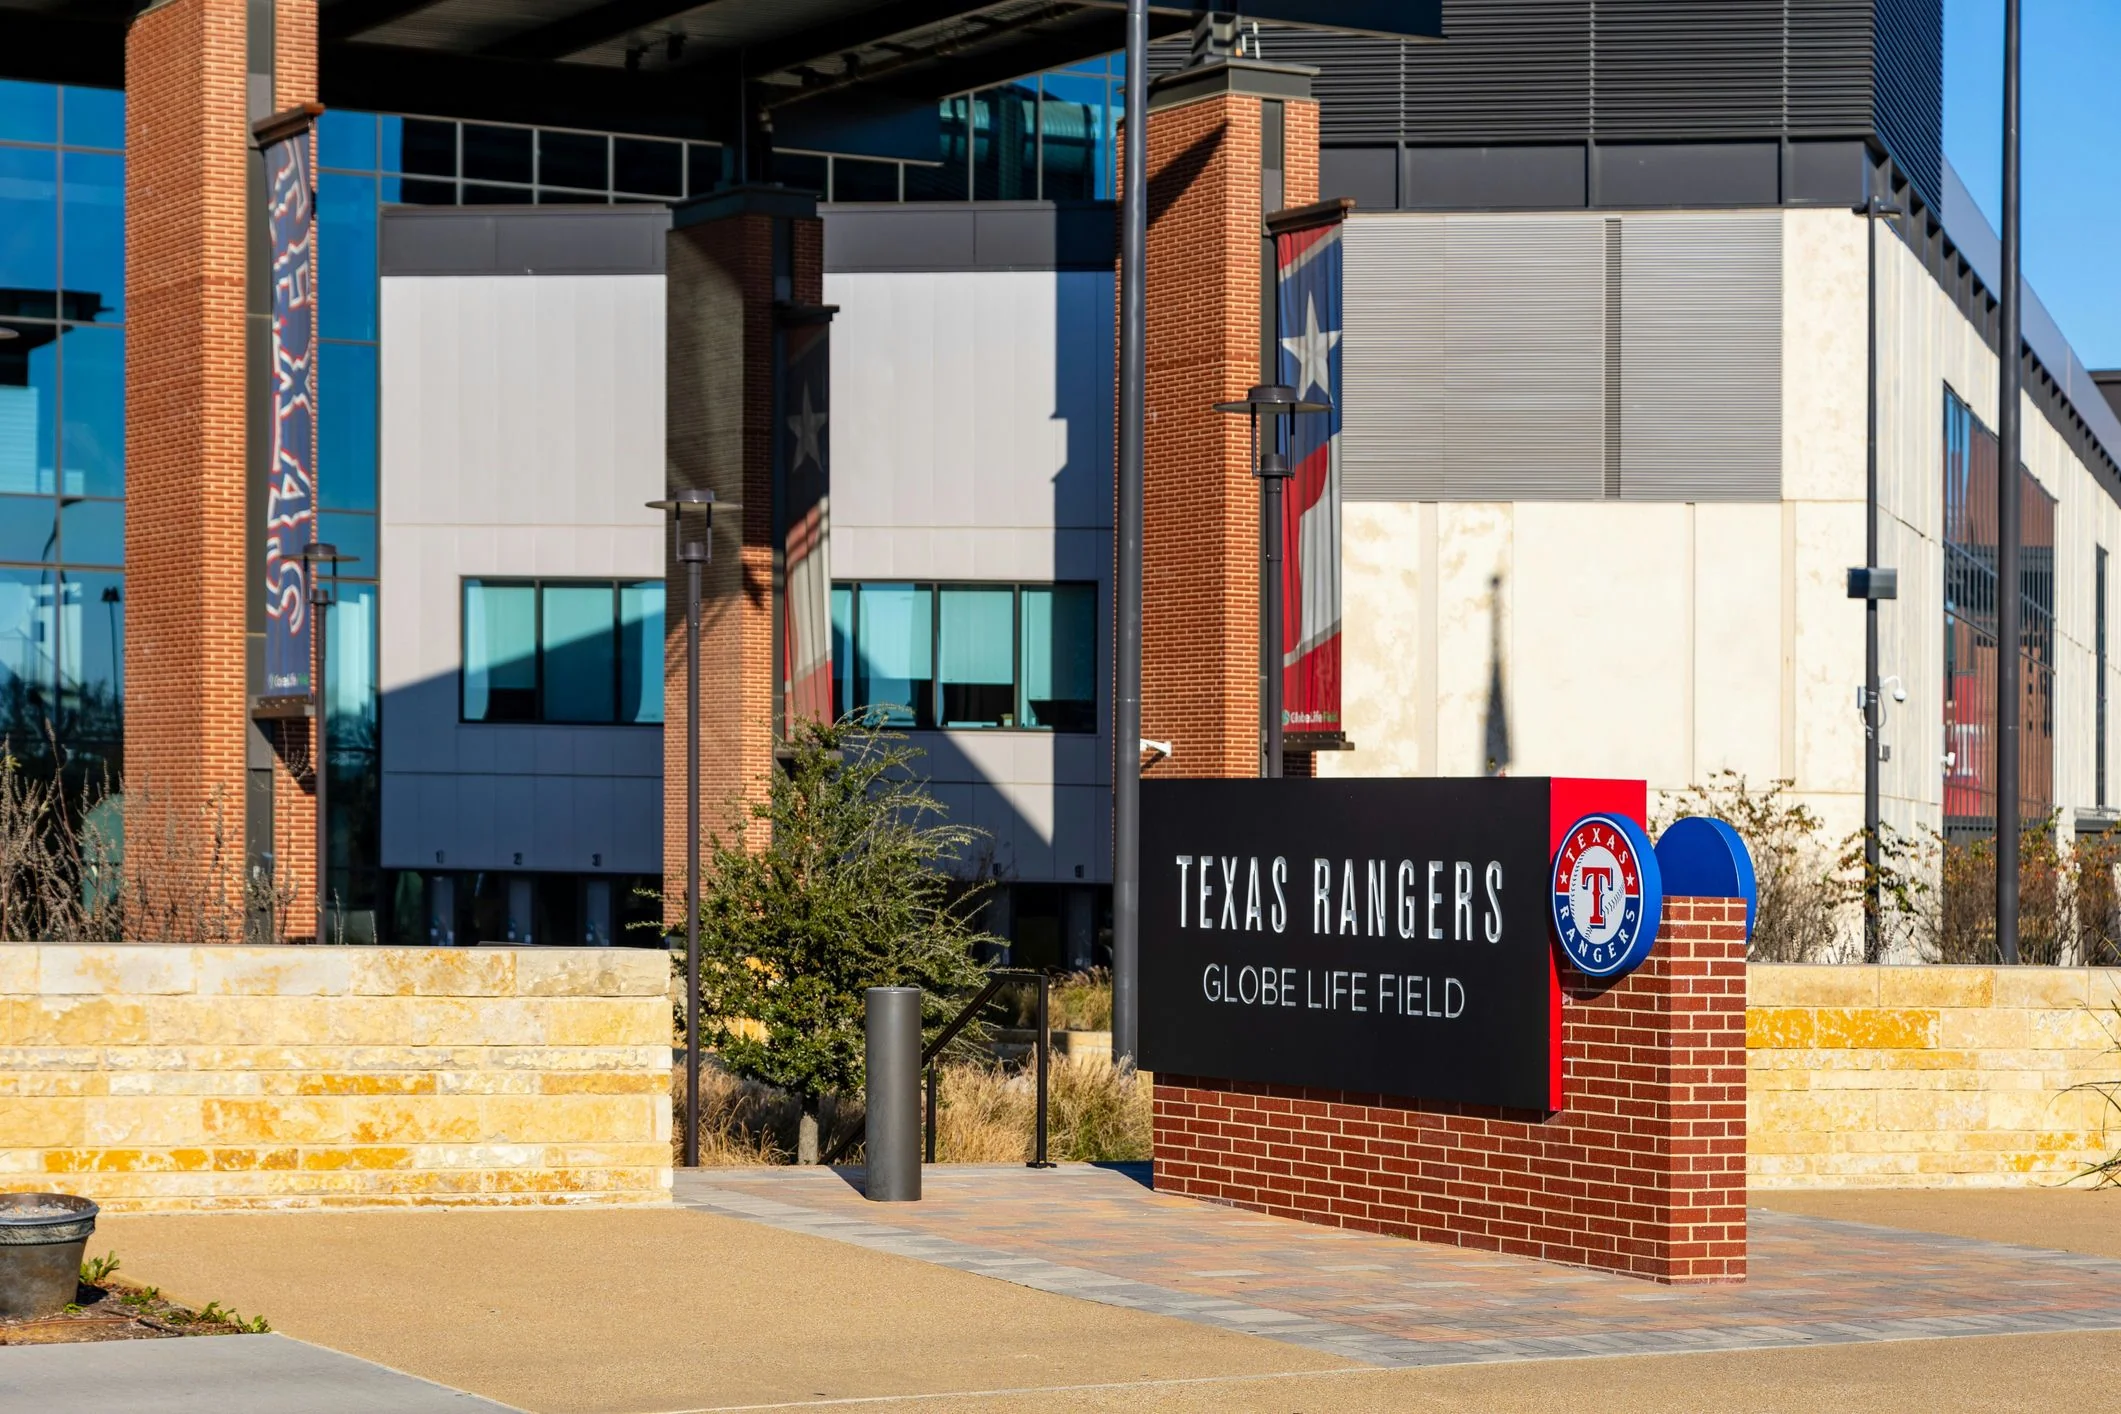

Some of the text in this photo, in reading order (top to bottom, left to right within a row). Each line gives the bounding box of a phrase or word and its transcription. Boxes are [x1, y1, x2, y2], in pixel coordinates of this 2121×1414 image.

[266, 137, 312, 636] TEXAS
[1565, 827, 1629, 865] TEXAS
[1175, 854, 1503, 944] TEXAS RANGERS
[1581, 866, 1614, 930] T
[1559, 908, 1636, 963] RANGERS
[1203, 963, 1465, 1019] GLOBE LIFE FIELD
